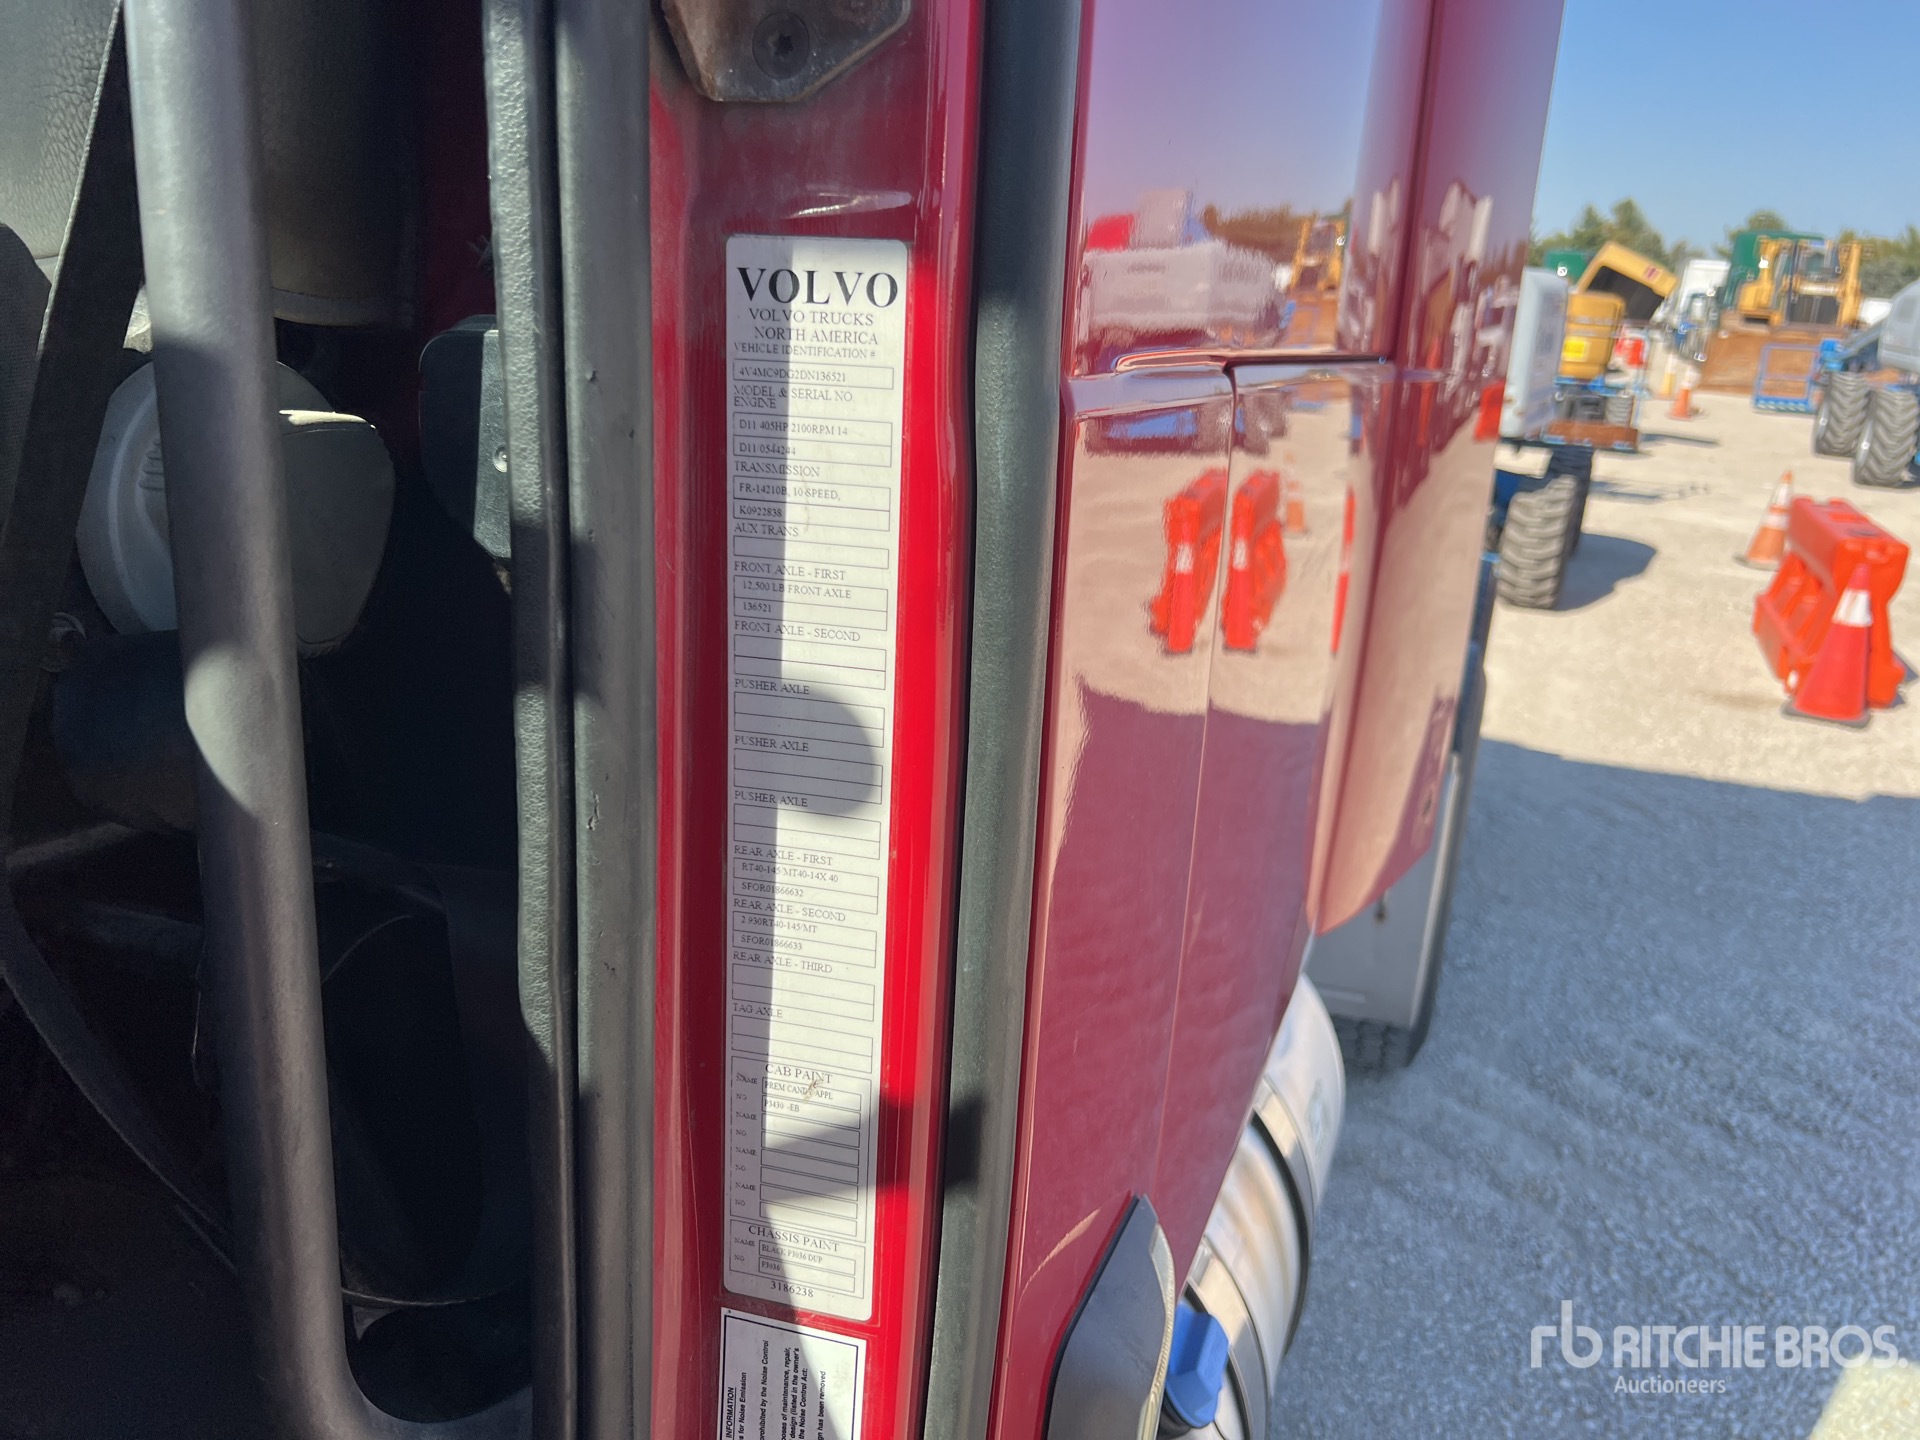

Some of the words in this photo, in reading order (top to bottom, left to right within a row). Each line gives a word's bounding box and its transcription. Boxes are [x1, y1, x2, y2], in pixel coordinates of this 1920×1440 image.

[737, 267, 898, 308] VOLVO
[749, 308, 804, 323] VOLVO
[809, 311, 874, 326] TRUCKS
[755, 326, 806, 341] NORTH
[810, 330, 878, 345] AMERICA
[734, 342, 779, 355] VEHICLE
[782, 345, 867, 359] IDENTIFICATION
[734, 385, 775, 397] MODEL
[778, 387, 788, 397] &
[791, 388, 833, 401] SERIAL
[734, 396, 776, 409] ENGINE
[760, 420, 789, 432] 405HP
[791, 423, 835, 435] 2100RPM
[735, 461, 820, 477] TRANSMISSION
[734, 523, 758, 534] AUX
[761, 524, 799, 537] TRANS
[734, 561, 771, 573] FRONT
[775, 563, 805, 577] AXLE
[814, 568, 847, 581] FIRST
[772, 583, 785, 593] LB
[788, 584, 822, 597] FRONT
[824, 588, 851, 599] AXLE
[743, 601, 772, 613] 136521
[734, 620, 771, 633] FRONT
[774, 624, 804, 637] AXLE
[814, 629, 861, 642] SECOND
[734, 678, 777, 692] PUSHER
[780, 682, 810, 695] AXLE
[734, 735, 777, 749] PUSHER
[780, 740, 809, 752] AXLE
[734, 790, 776, 804] PUSHER
[779, 795, 808, 808] AXLE
[734, 845, 763, 857] REAR
[765, 849, 794, 861] AXLE
[803, 853, 833, 866] FIRST
[733, 898, 762, 910] REAR
[765, 902, 794, 914] AXLE
[802, 907, 847, 922] SECOND
[733, 951, 761, 964] REAR
[764, 955, 792, 968] AXLE
[800, 960, 833, 974] THIRD
[733, 1003, 754, 1014] TAG
[755, 1007, 783, 1019] AXLE
[736, 1072, 758, 1085] NAME
[765, 1063, 792, 1077] CAB
[795, 1067, 833, 1084] PAINT
[736, 1111, 757, 1121] NAME
[735, 1146, 757, 1156] NAME
[735, 1181, 757, 1191] NAME
[734, 1237, 755, 1247] NAME
[748, 1225, 800, 1244] CHASSIS
[803, 1236, 840, 1252] PAINT
[770, 1280, 814, 1298] 3186238
[739, 1372, 747, 1403] Emission
[760, 1397, 768, 1406] by
[725, 1386, 735, 1438] INFORMATION
[781, 1413, 788, 1421] of
[789, 1417, 798, 1439] design
